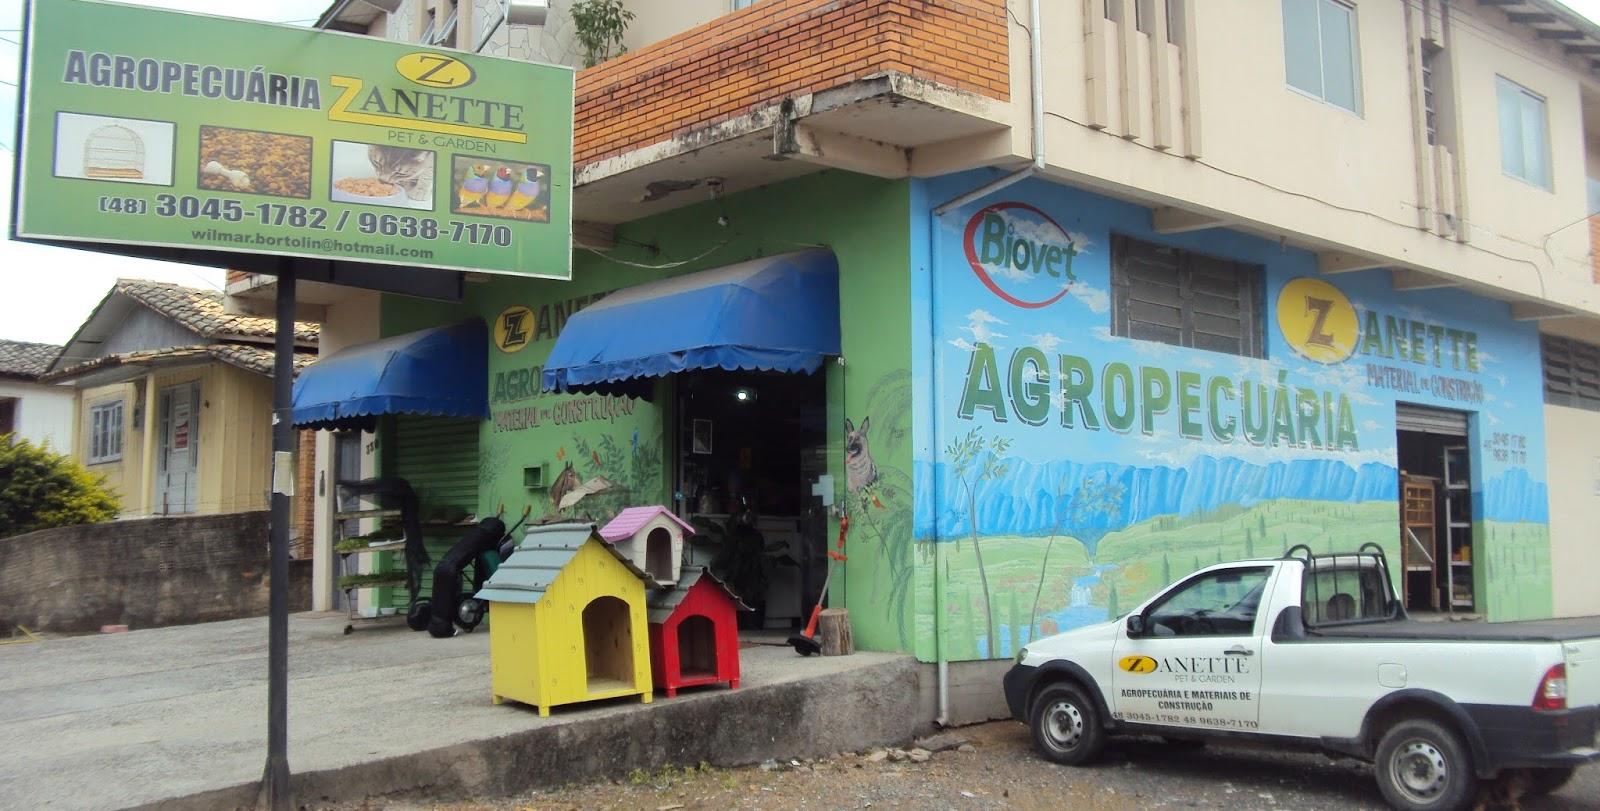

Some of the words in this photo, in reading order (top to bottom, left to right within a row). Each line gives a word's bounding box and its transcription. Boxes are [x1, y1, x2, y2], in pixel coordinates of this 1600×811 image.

[63, 50, 321, 111] AGROPECUÁRIA
[328, 75, 527, 133] ZANETTE
[387, 130, 415, 144] PET
[418, 133, 429, 145] &
[433, 136, 496, 153] GARDEN
[99, 196, 147, 214] (48)
[156, 194, 328, 230] 3045-1782
[335, 210, 350, 232] /
[358, 211, 512, 247] 9638-7170
[192, 228, 434, 259] wilmar.bortolin@hotmail.com
[981, 212, 1078, 281] Biovet
[1366, 363, 1421, 394] MATERIAL
[958, 341, 1360, 451] AGROPECUÁRIA
[1121, 688, 1182, 699] AGROPECUÁRIA
[1184, 690, 1190, 699] E
[1192, 690, 1237, 700] MATERIAIS
[1239, 691, 1252, 701] DE
[1175, 674, 1188, 683] PET
[1191, 675, 1197, 683] &
[1200, 674, 1235, 684] GARDEN
[1126, 712, 1180, 723] 3045-1782
[1200, 717, 1258, 729] 9638-7170
[1158, 701, 1214, 711] CONSTRUÇÃO
